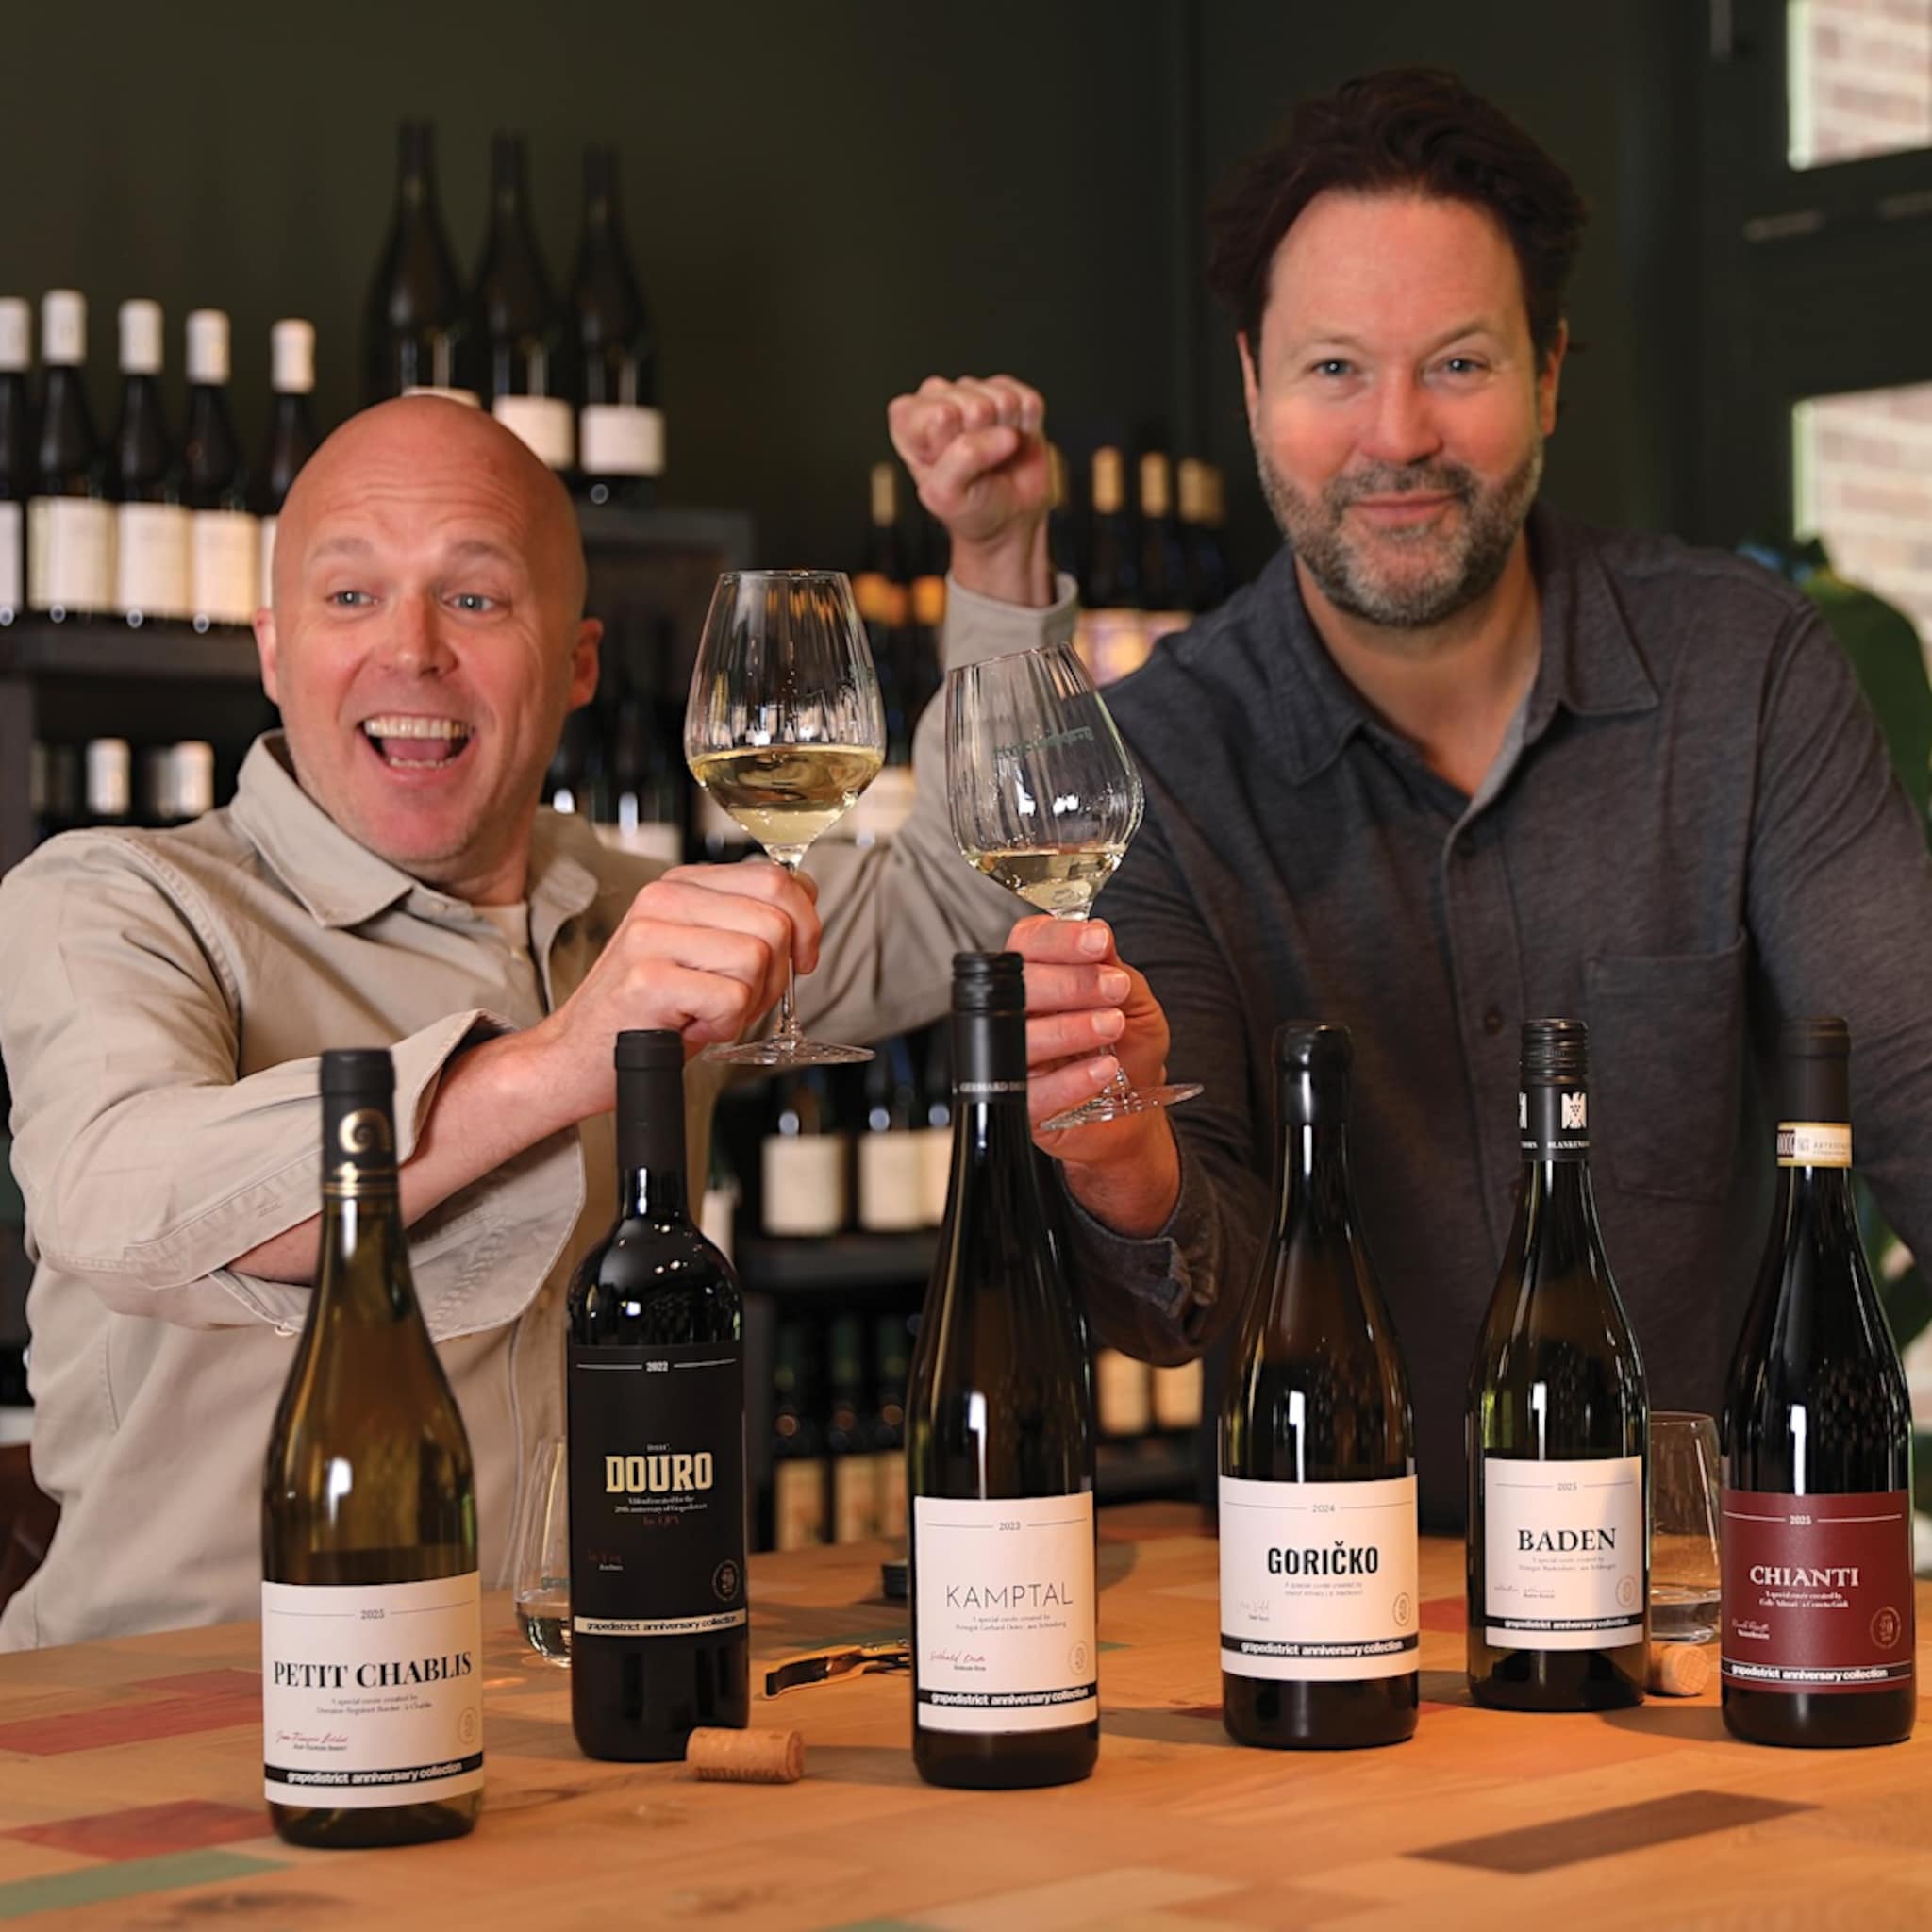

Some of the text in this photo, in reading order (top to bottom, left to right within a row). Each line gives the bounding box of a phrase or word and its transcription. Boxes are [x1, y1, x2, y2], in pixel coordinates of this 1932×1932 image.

[604, 1452, 714, 1494] DOURO
[1312, 1504, 1335, 1513] 2024
[1518, 1527, 1616, 1552] BADEN
[1268, 1541, 1378, 1574] GORIČKO
[1750, 1565, 1859, 1587] CHIANTI
[946, 1582, 1074, 1608] KAMPTAL
[586, 1615, 737, 1632] grapedistrict anniversary collection
[1241, 1641, 1404, 1657] grapedistrict anniversary collection
[274, 1652, 472, 1688] PETIT CHABLIS
[1782, 1668, 1842, 1682] anniversary
[1843, 1667, 1888, 1680] collection
[930, 1691, 990, 1706] grapedistrict
[991, 1691, 1051, 1707] anniversary
[287, 1761, 462, 1785] grapedistrict anniversary collection
